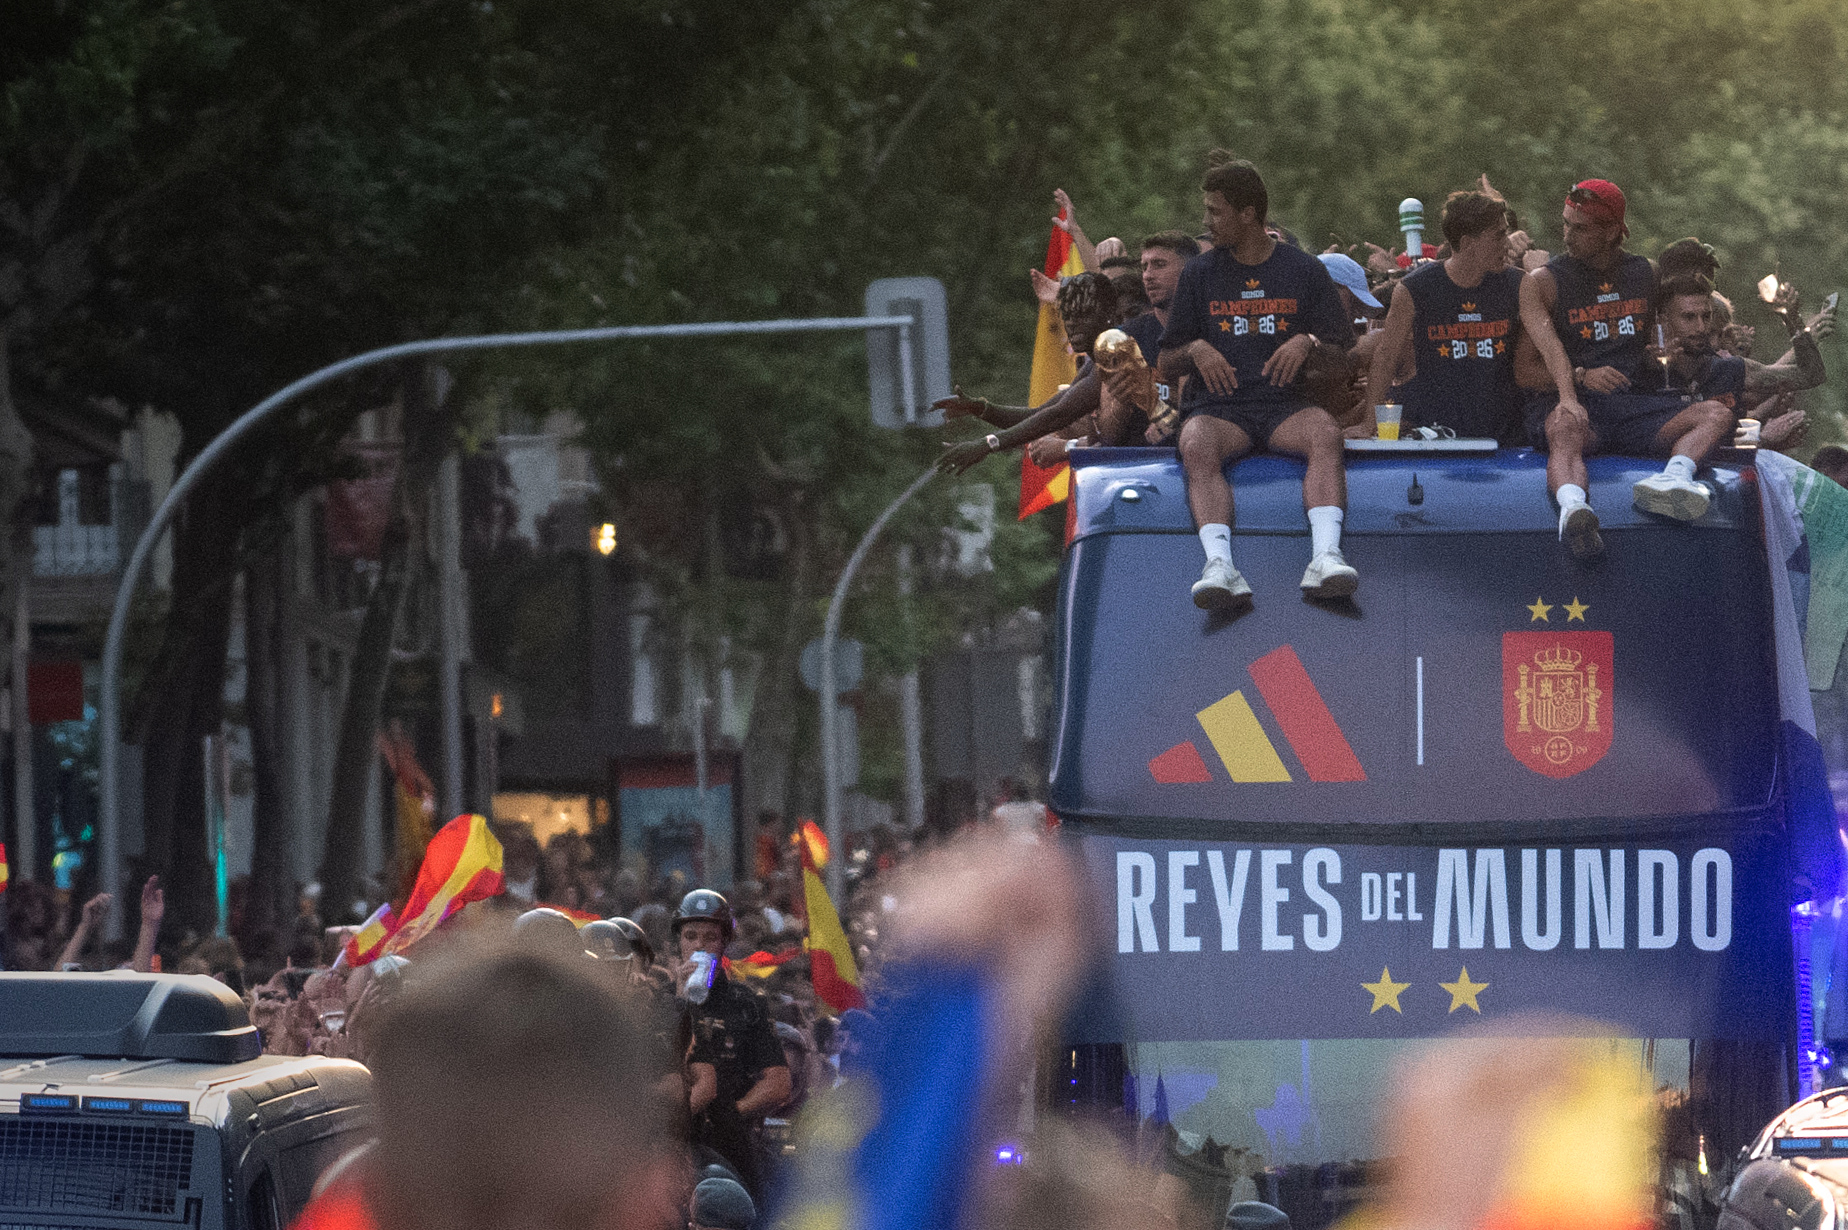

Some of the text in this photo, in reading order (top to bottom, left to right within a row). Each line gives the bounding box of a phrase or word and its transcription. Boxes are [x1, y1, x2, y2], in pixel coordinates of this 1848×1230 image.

[1241, 289, 1265, 299] SOMOS
[1596, 292, 1620, 304] SOMOS
[1209, 298, 1298, 316] CAMPEONES
[1233, 314, 1275, 336] 20 26
[1458, 313, 1482, 323] SOMOS
[1593, 315, 1636, 342] 20 26
[1452, 338, 1494, 360] 20 26
[1116, 847, 1734, 953] REYES DEL MUNDO
